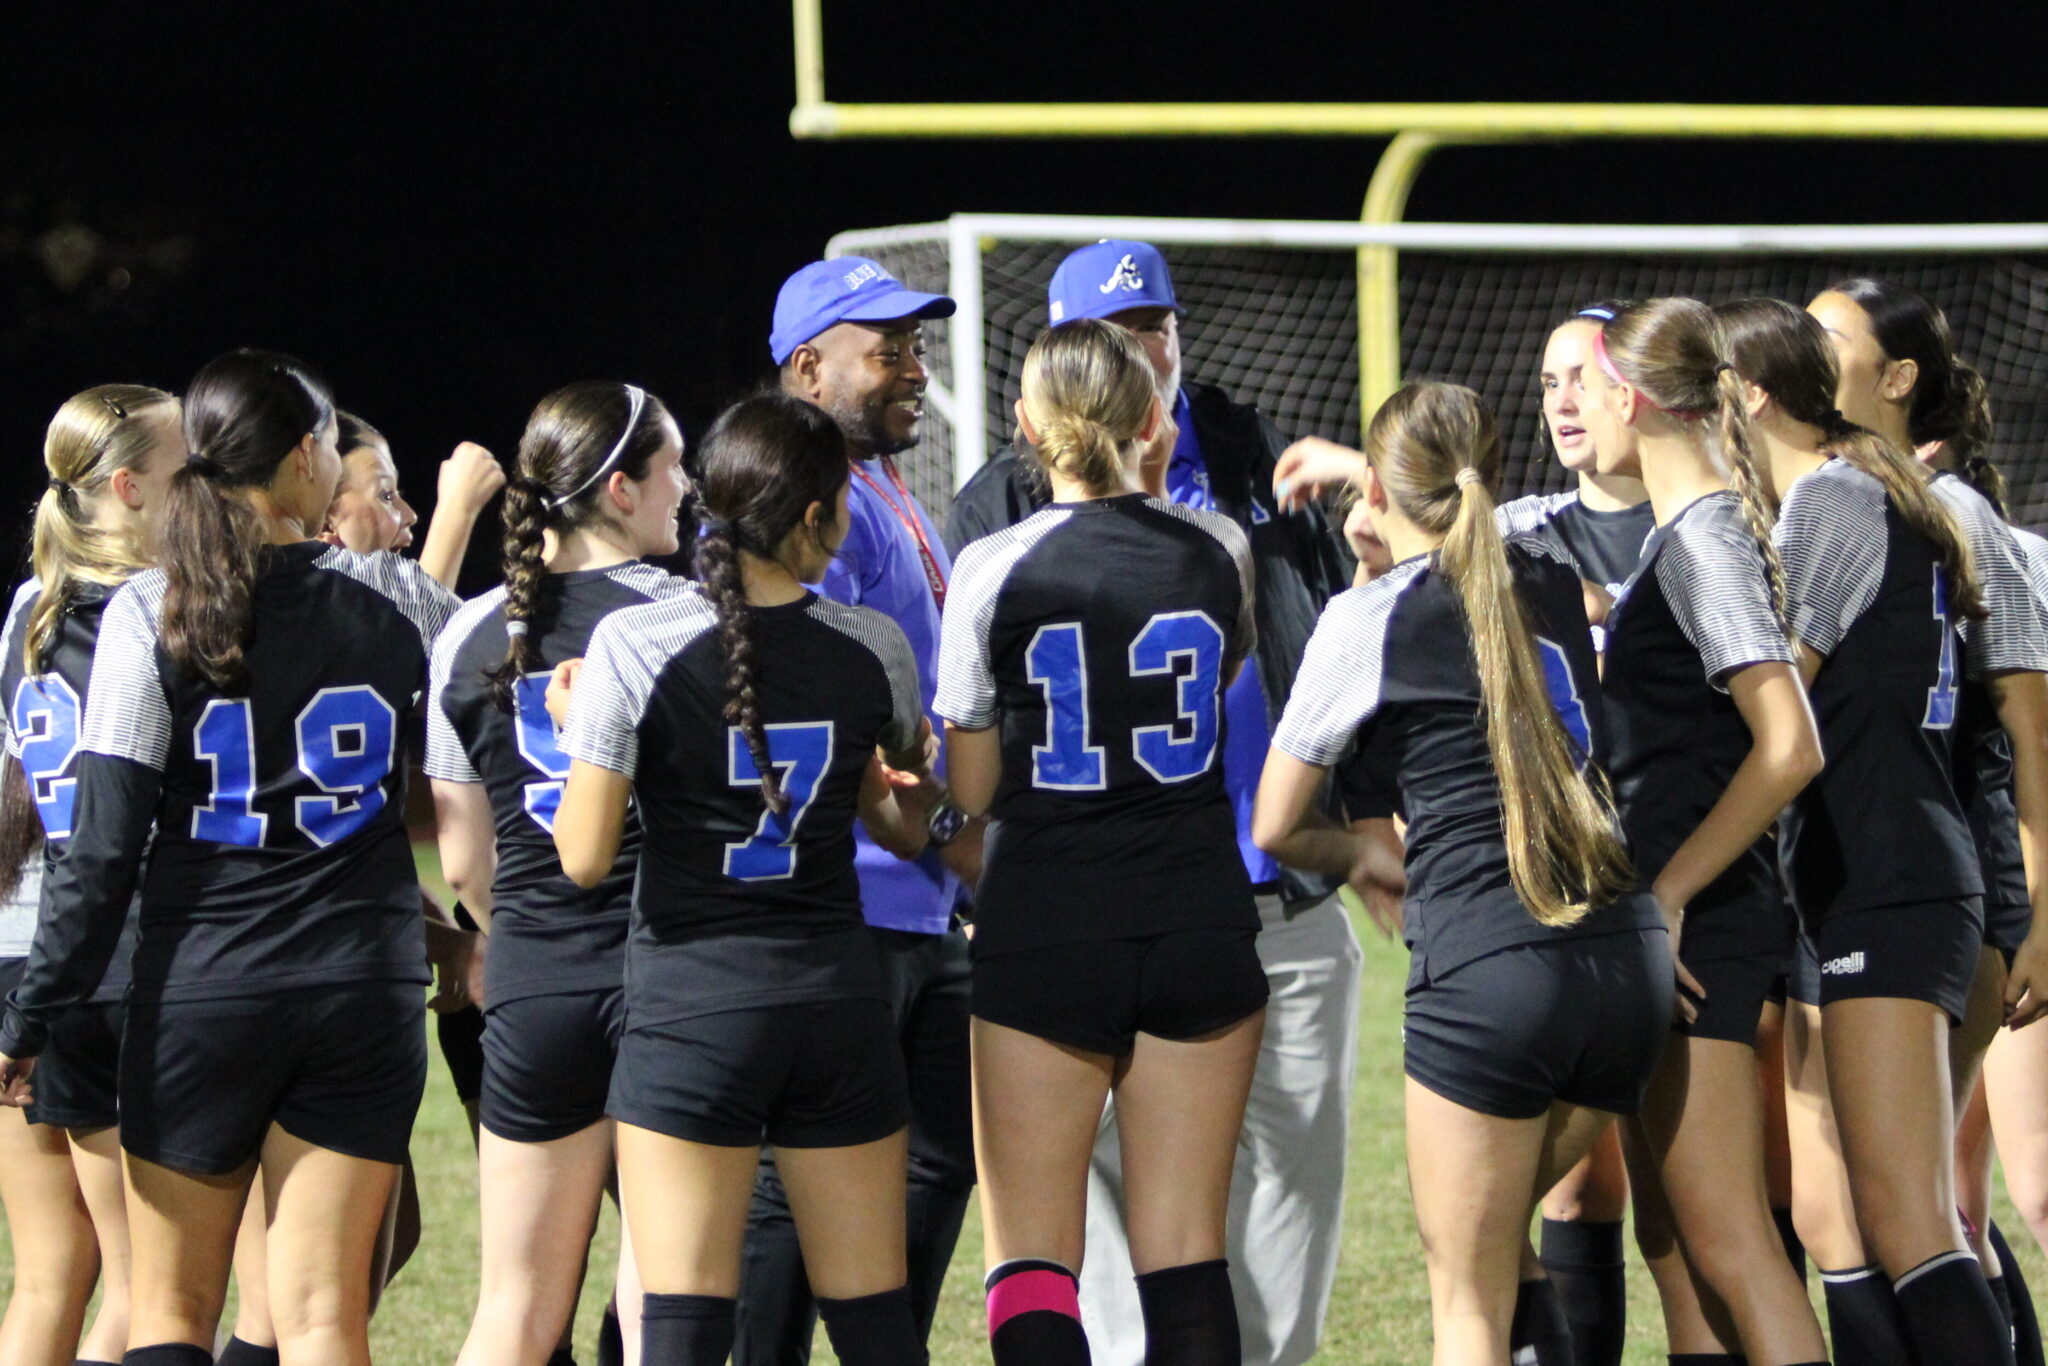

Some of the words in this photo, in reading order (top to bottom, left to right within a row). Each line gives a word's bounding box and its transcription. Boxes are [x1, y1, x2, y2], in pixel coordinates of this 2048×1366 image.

[191, 685, 396, 847] 19
[1025, 610, 1224, 791] 13
[722, 721, 834, 881] 7
